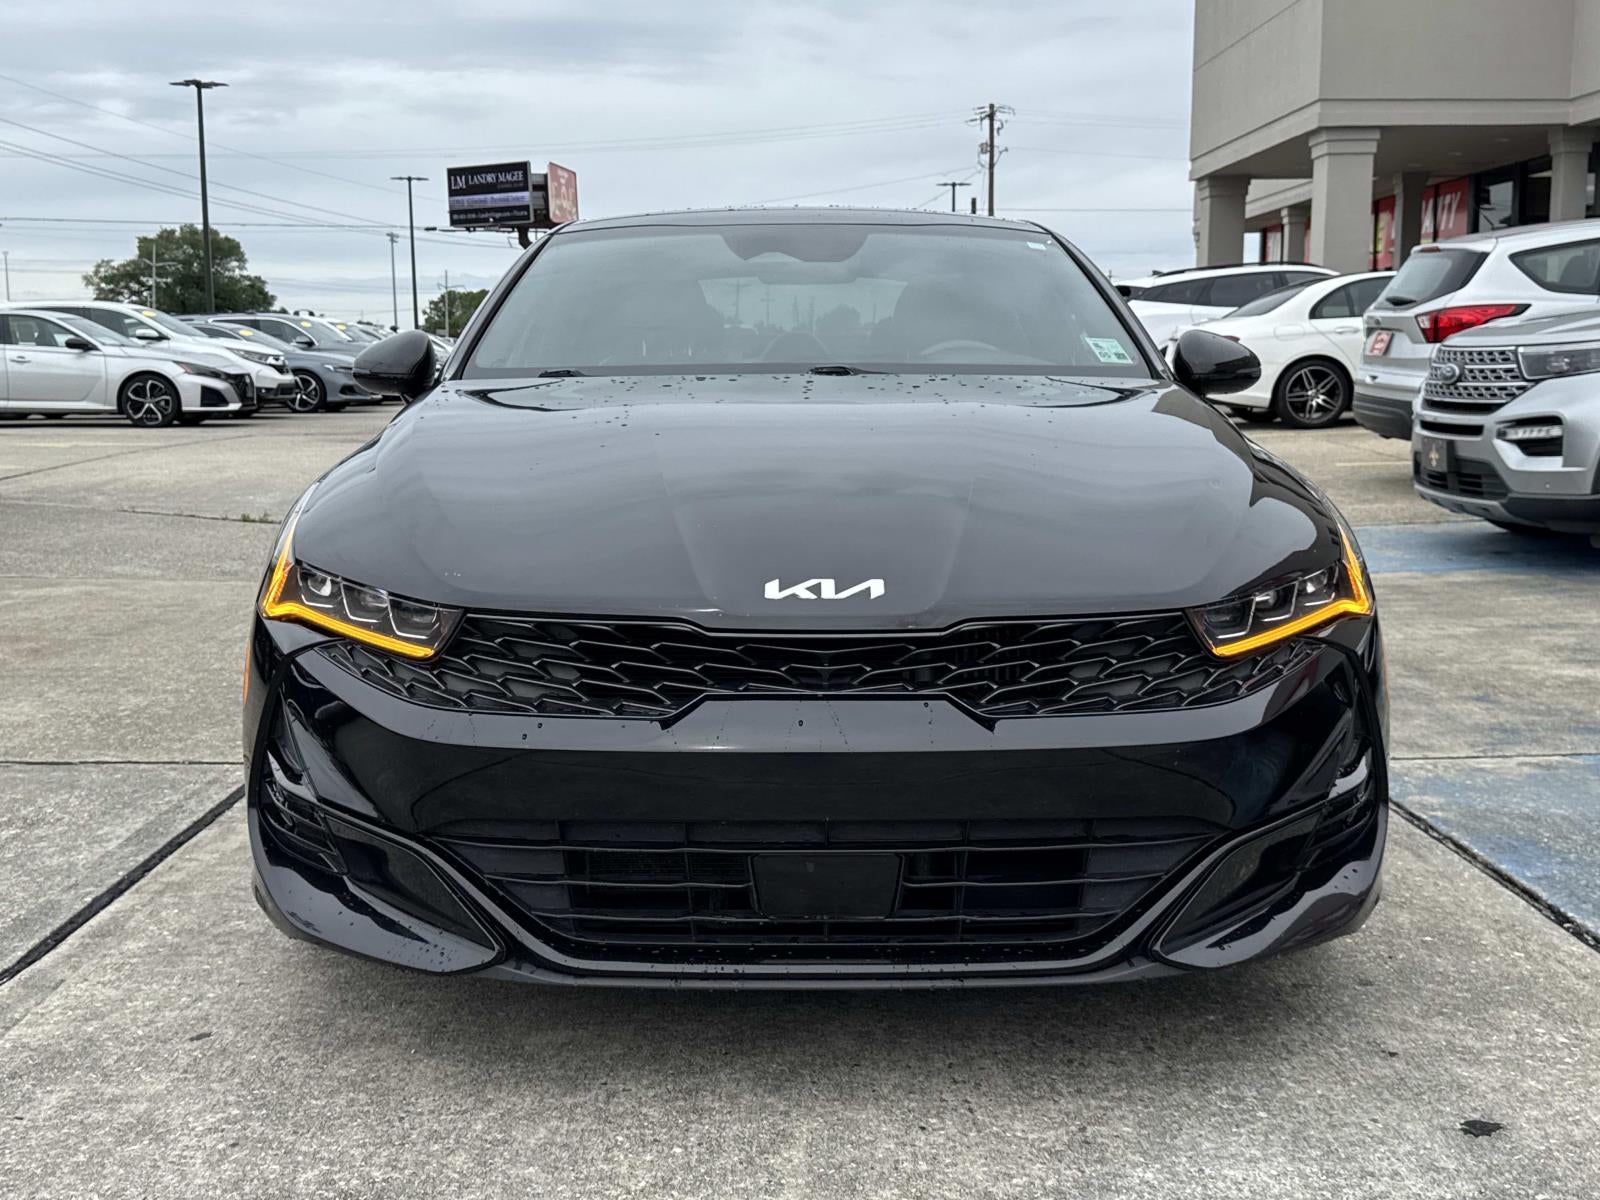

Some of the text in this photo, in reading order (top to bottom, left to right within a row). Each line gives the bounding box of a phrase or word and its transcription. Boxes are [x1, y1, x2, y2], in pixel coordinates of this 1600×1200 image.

[451, 175, 466, 190] LM
[468, 170, 524, 185] LANDRY MAGEE
[764, 578, 885, 600] KIA
